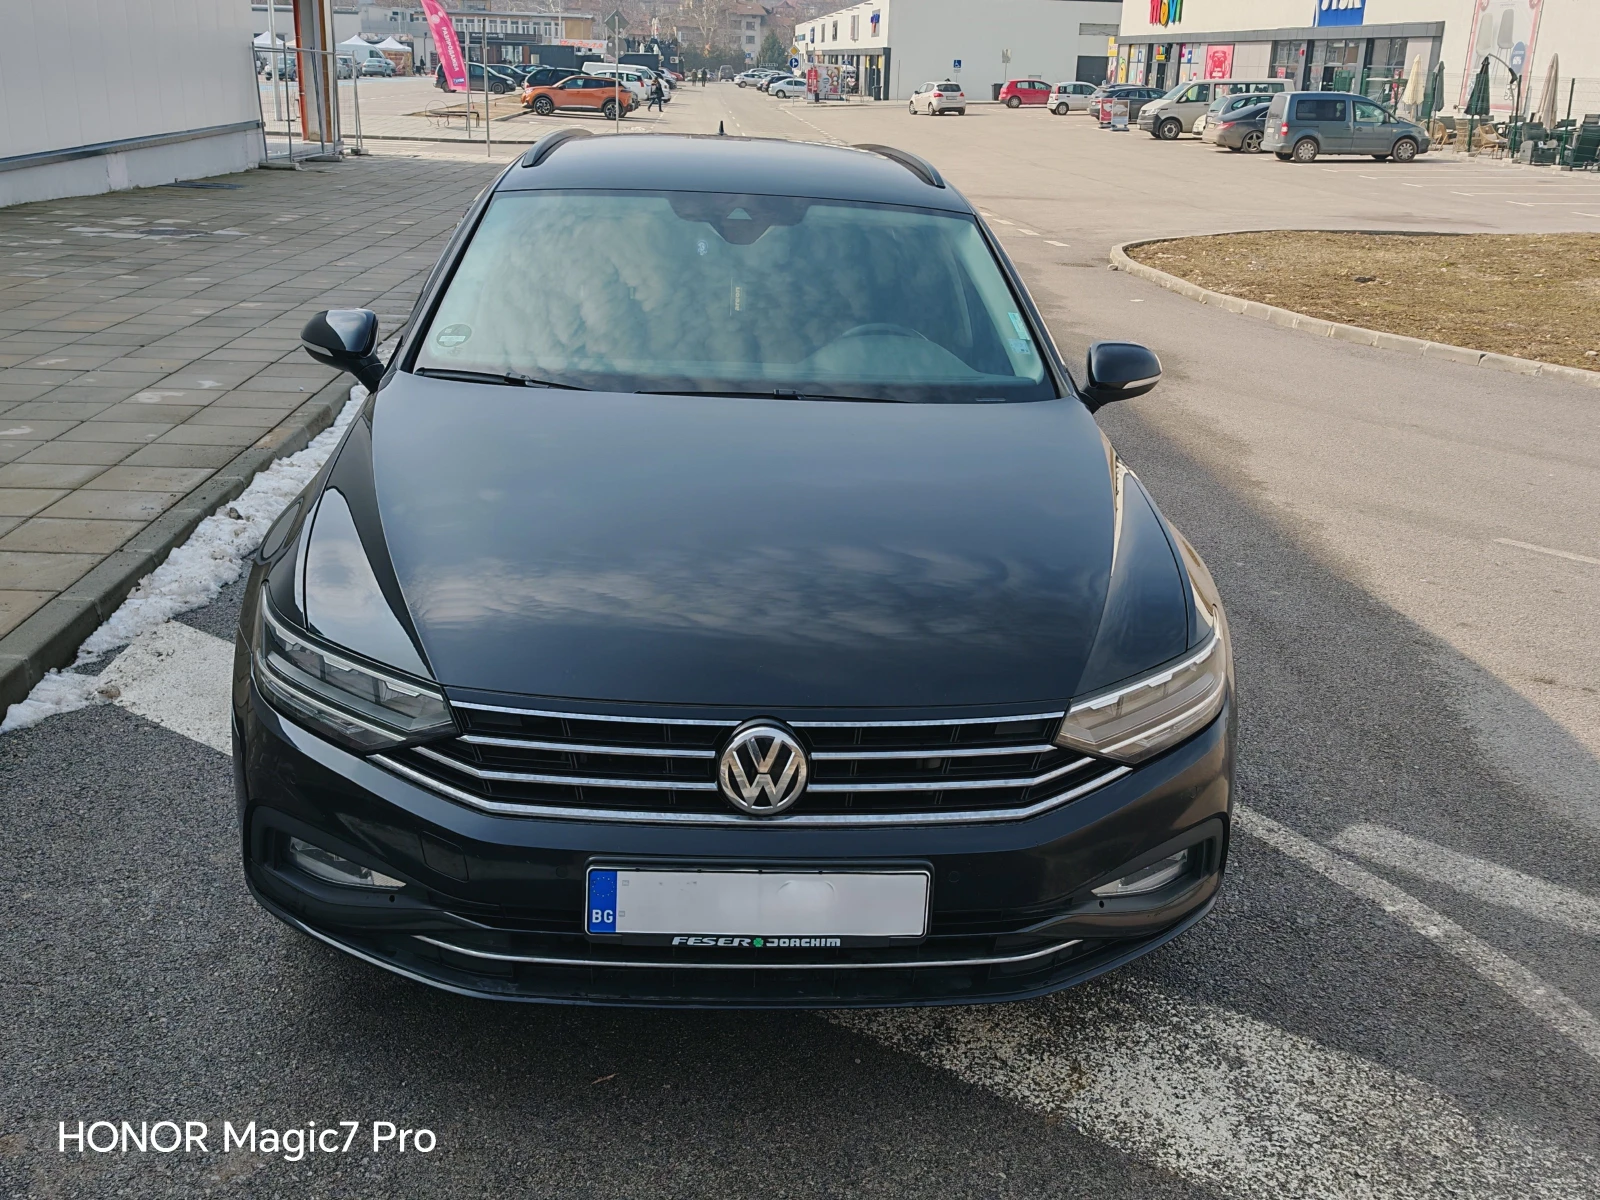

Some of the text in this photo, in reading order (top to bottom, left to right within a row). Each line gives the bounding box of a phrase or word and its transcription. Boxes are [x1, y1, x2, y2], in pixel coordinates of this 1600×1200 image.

[724, 731, 803, 811] VW
[592, 909, 613, 923] BG
[671, 936, 841, 947] FESER JOACHIM
